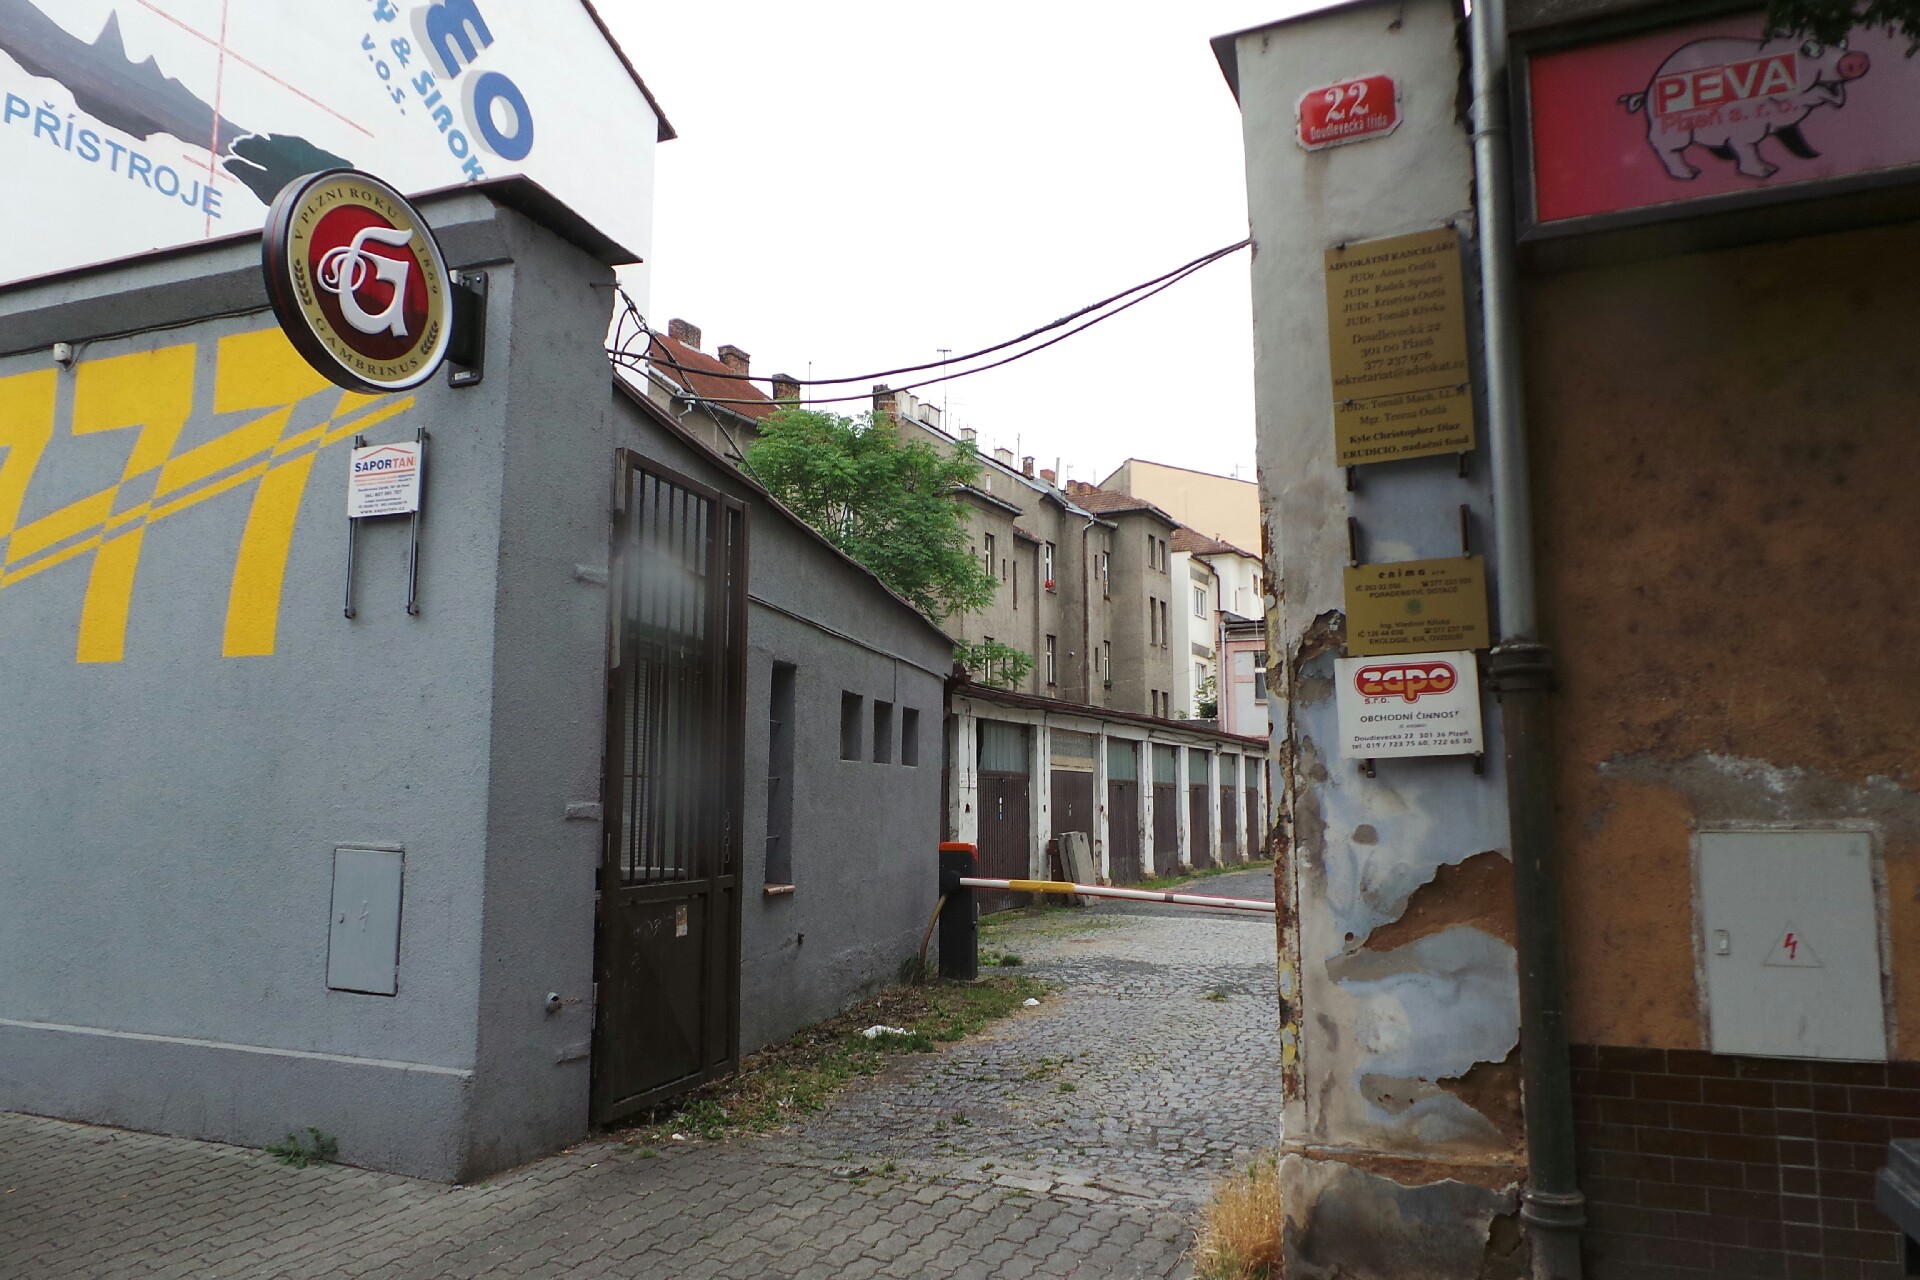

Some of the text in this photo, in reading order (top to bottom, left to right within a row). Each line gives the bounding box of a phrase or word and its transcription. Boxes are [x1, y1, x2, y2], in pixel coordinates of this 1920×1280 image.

[1657, 55, 1797, 115] PEVA
[390, 37, 411, 69] &
[411, 70, 487, 182] ŠIROK
[1324, 81, 1369, 123] 22
[1310, 112, 1388, 141] Doudlevecká třída
[4, 91, 224, 220] PŘÍSTROJE
[294, 231, 304, 241] V
[301, 187, 344, 225] PLZNI
[350, 187, 399, 219] ROKU
[1427, 322, 1441, 333] 22
[315, 317, 419, 377] GAMBRINUS
[1361, 347, 1381, 358] 301
[1364, 358, 1384, 371] 377
[1349, 434, 1372, 445] Kyle
[1373, 426, 1435, 443] Christopher
[354, 456, 414, 473] SAPORTAN
[1362, 667, 1452, 699] zapo
[1364, 697, 1390, 705] s.r.o.
[1360, 710, 1460, 723] OBCHODNÍ ČINNOST
[1354, 733, 1402, 742] Doudlevecká
